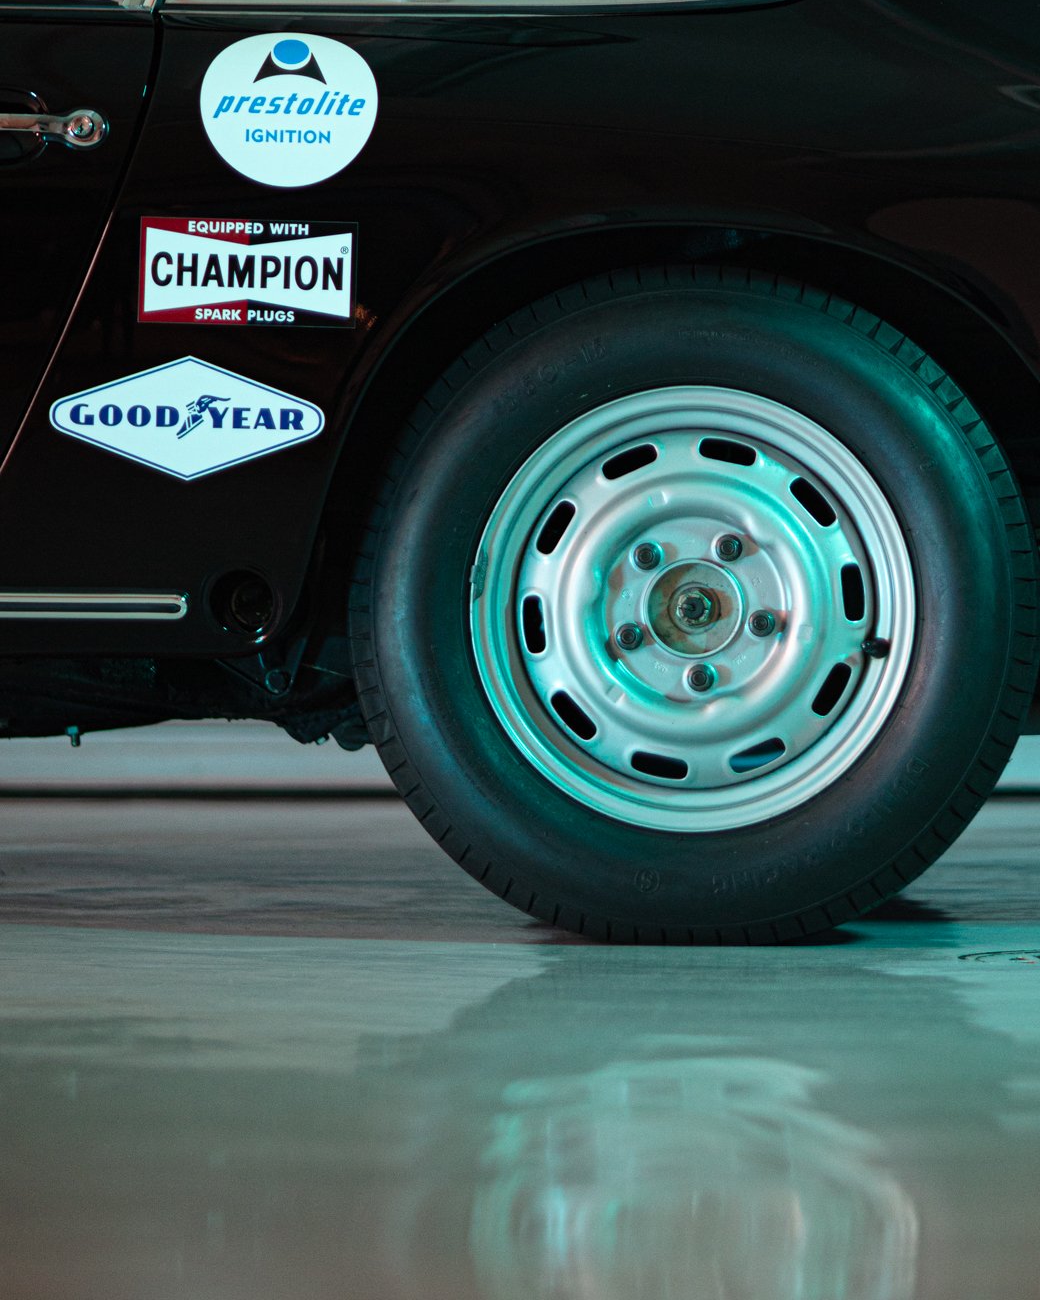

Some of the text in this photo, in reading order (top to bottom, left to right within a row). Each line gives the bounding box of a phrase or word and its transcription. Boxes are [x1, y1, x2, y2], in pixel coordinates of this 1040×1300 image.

[212, 90, 366, 119] prestolite
[245, 128, 331, 144] IGNITION
[187, 220, 309, 236] EQUIPPED WITH
[151, 251, 344, 291] CHAMPION
[195, 308, 295, 323] SPARK PLUGS
